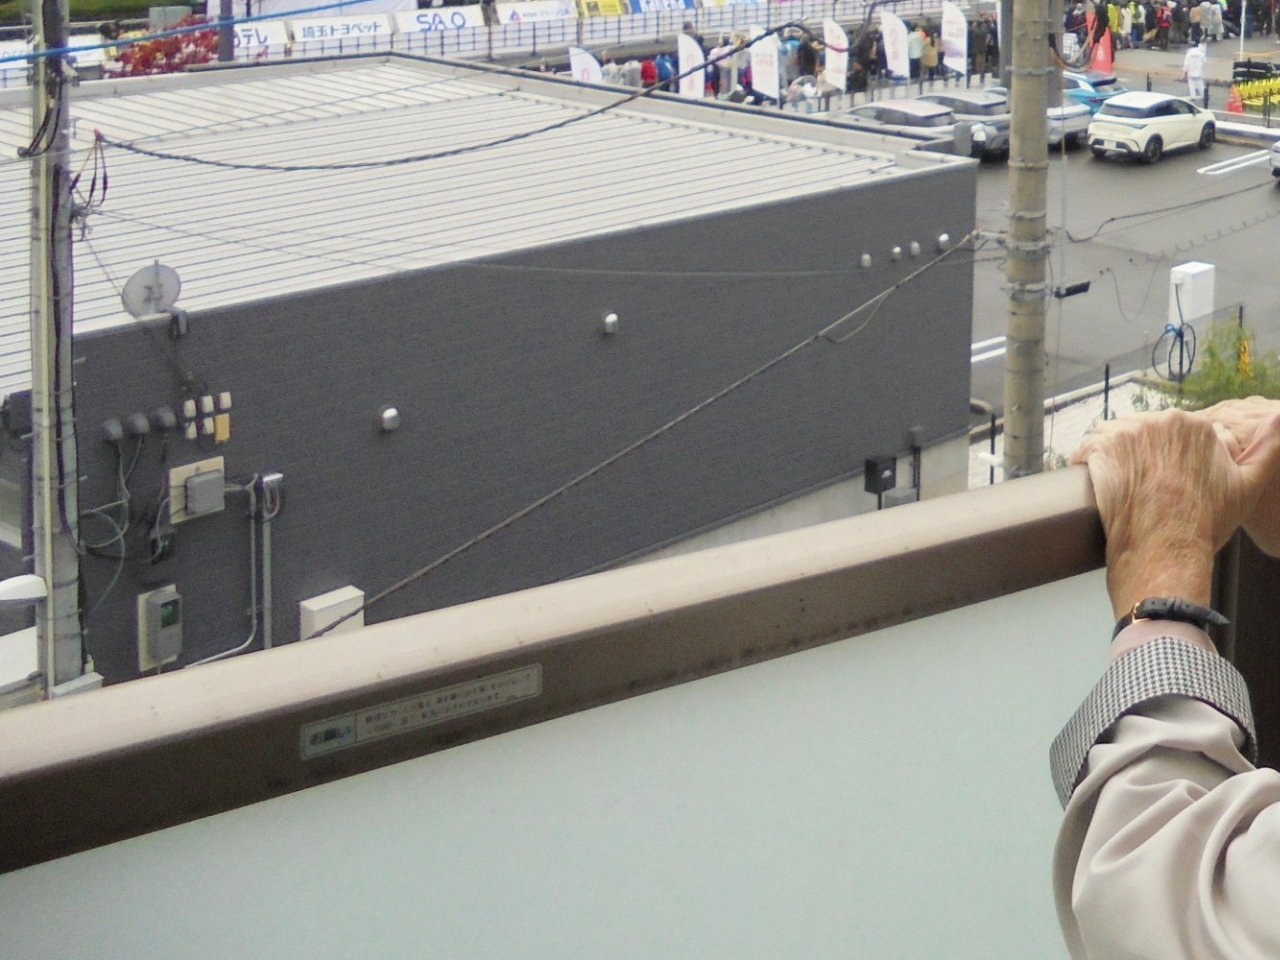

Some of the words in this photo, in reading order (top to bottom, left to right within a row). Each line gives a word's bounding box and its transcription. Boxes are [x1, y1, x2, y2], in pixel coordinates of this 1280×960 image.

[301, 21, 383, 39] 埼玉トヨペット
